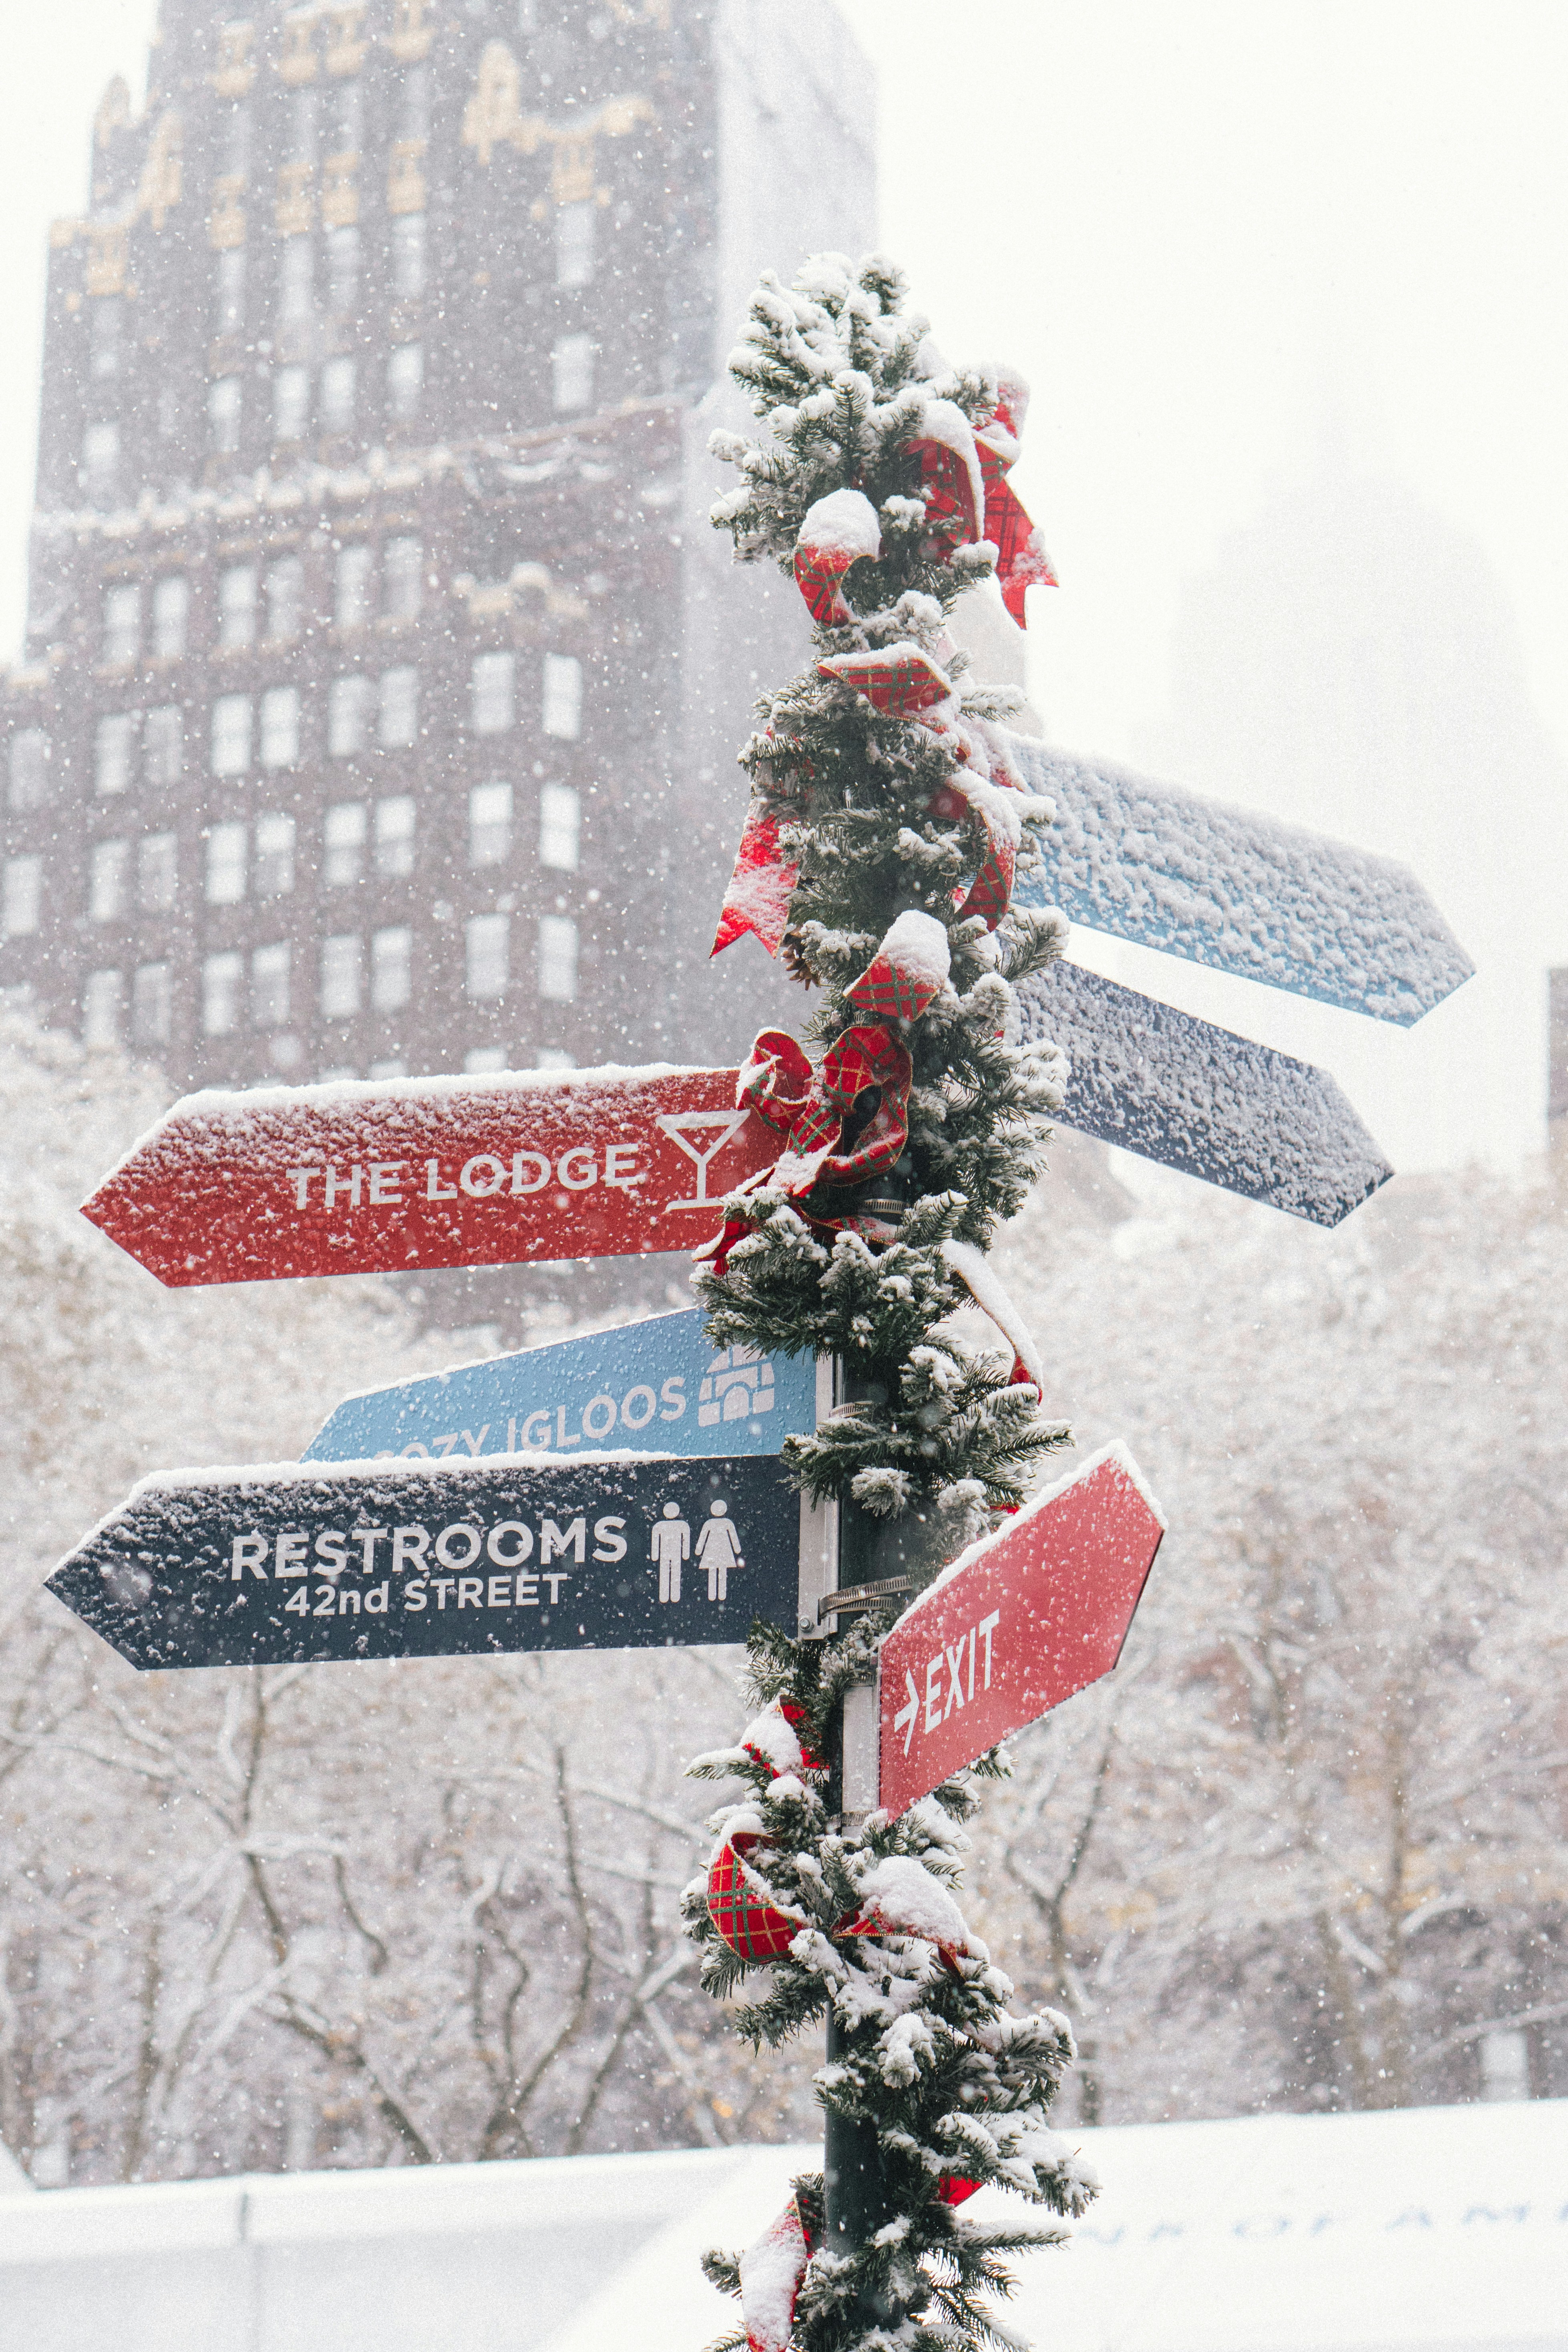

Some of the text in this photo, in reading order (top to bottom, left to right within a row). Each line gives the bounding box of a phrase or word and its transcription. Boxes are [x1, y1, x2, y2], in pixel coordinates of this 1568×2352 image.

[286, 1143, 642, 1210] THE LODGE
[372, 1376, 687, 1460] ZY IGLOOS
[231, 1516, 628, 1581] RESTROOMS
[285, 1572, 568, 1616] 42nd STREET
[924, 1608, 1000, 1735] EXIT
